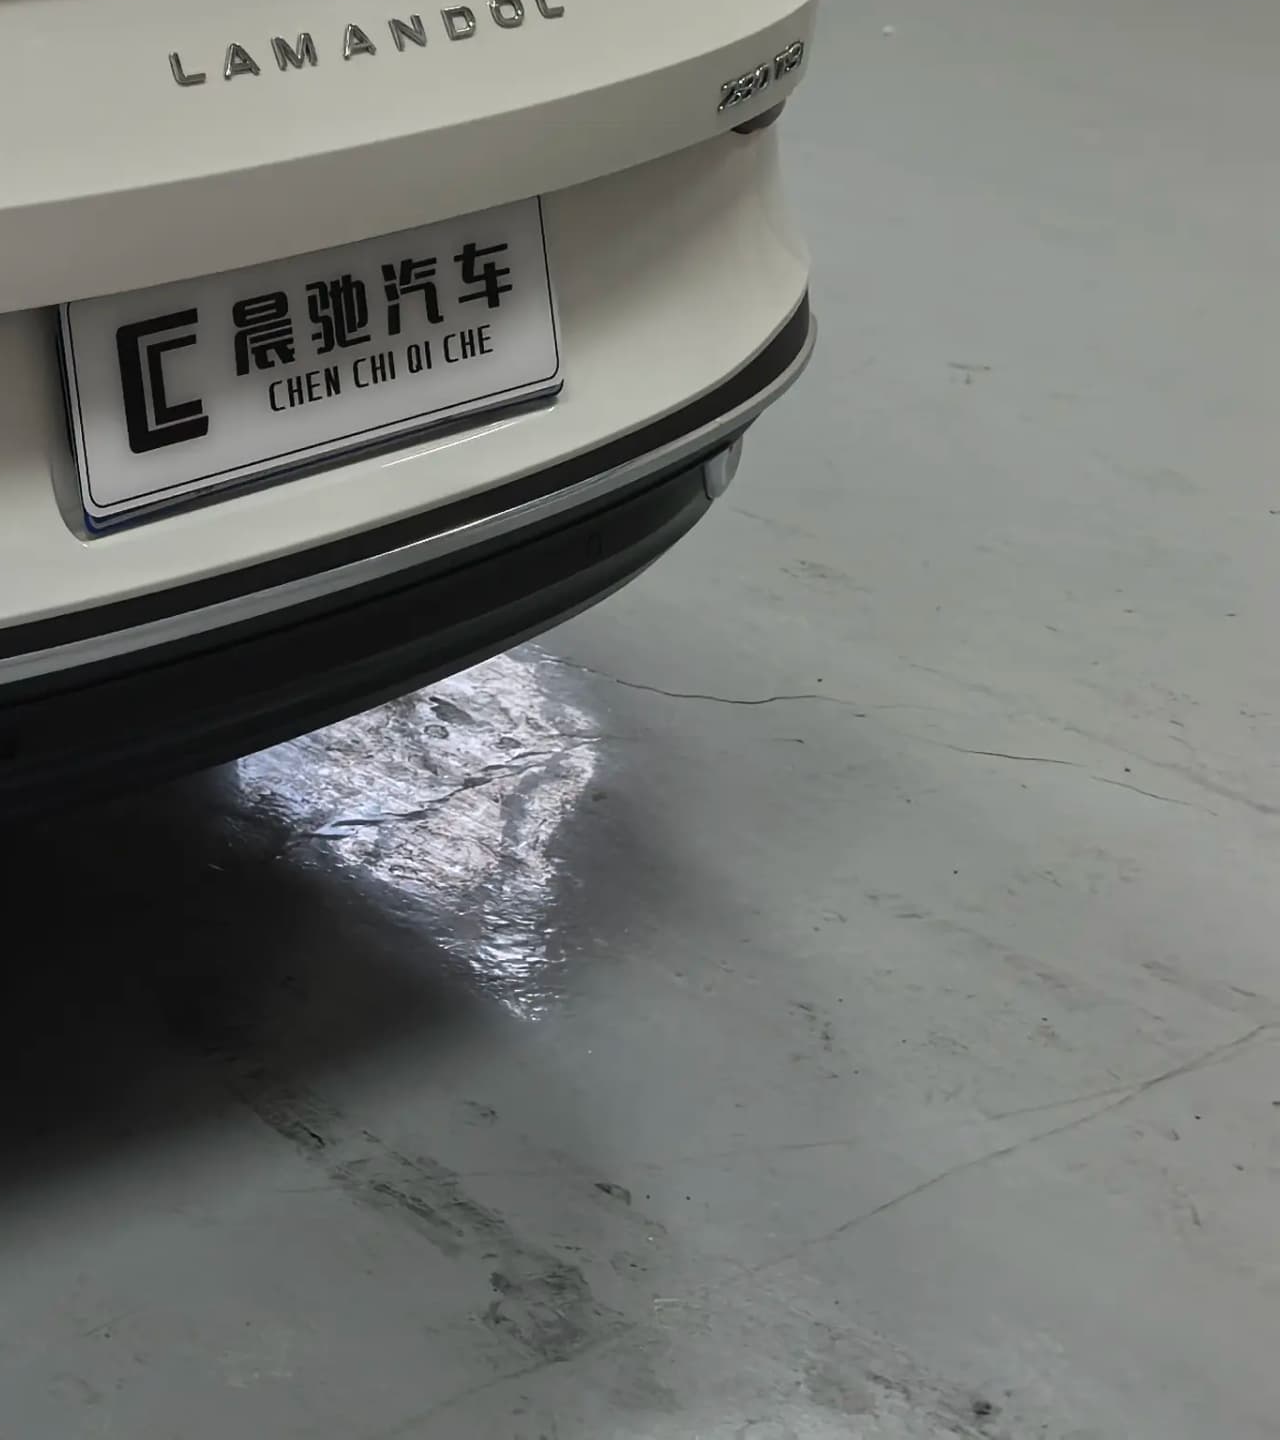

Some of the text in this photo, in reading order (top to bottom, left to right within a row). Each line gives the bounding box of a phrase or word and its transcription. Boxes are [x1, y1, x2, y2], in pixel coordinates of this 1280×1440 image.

[231, 242, 513, 376] 晨驰汽车
[268, 324, 494, 411] CHEN CHI QI CHE
